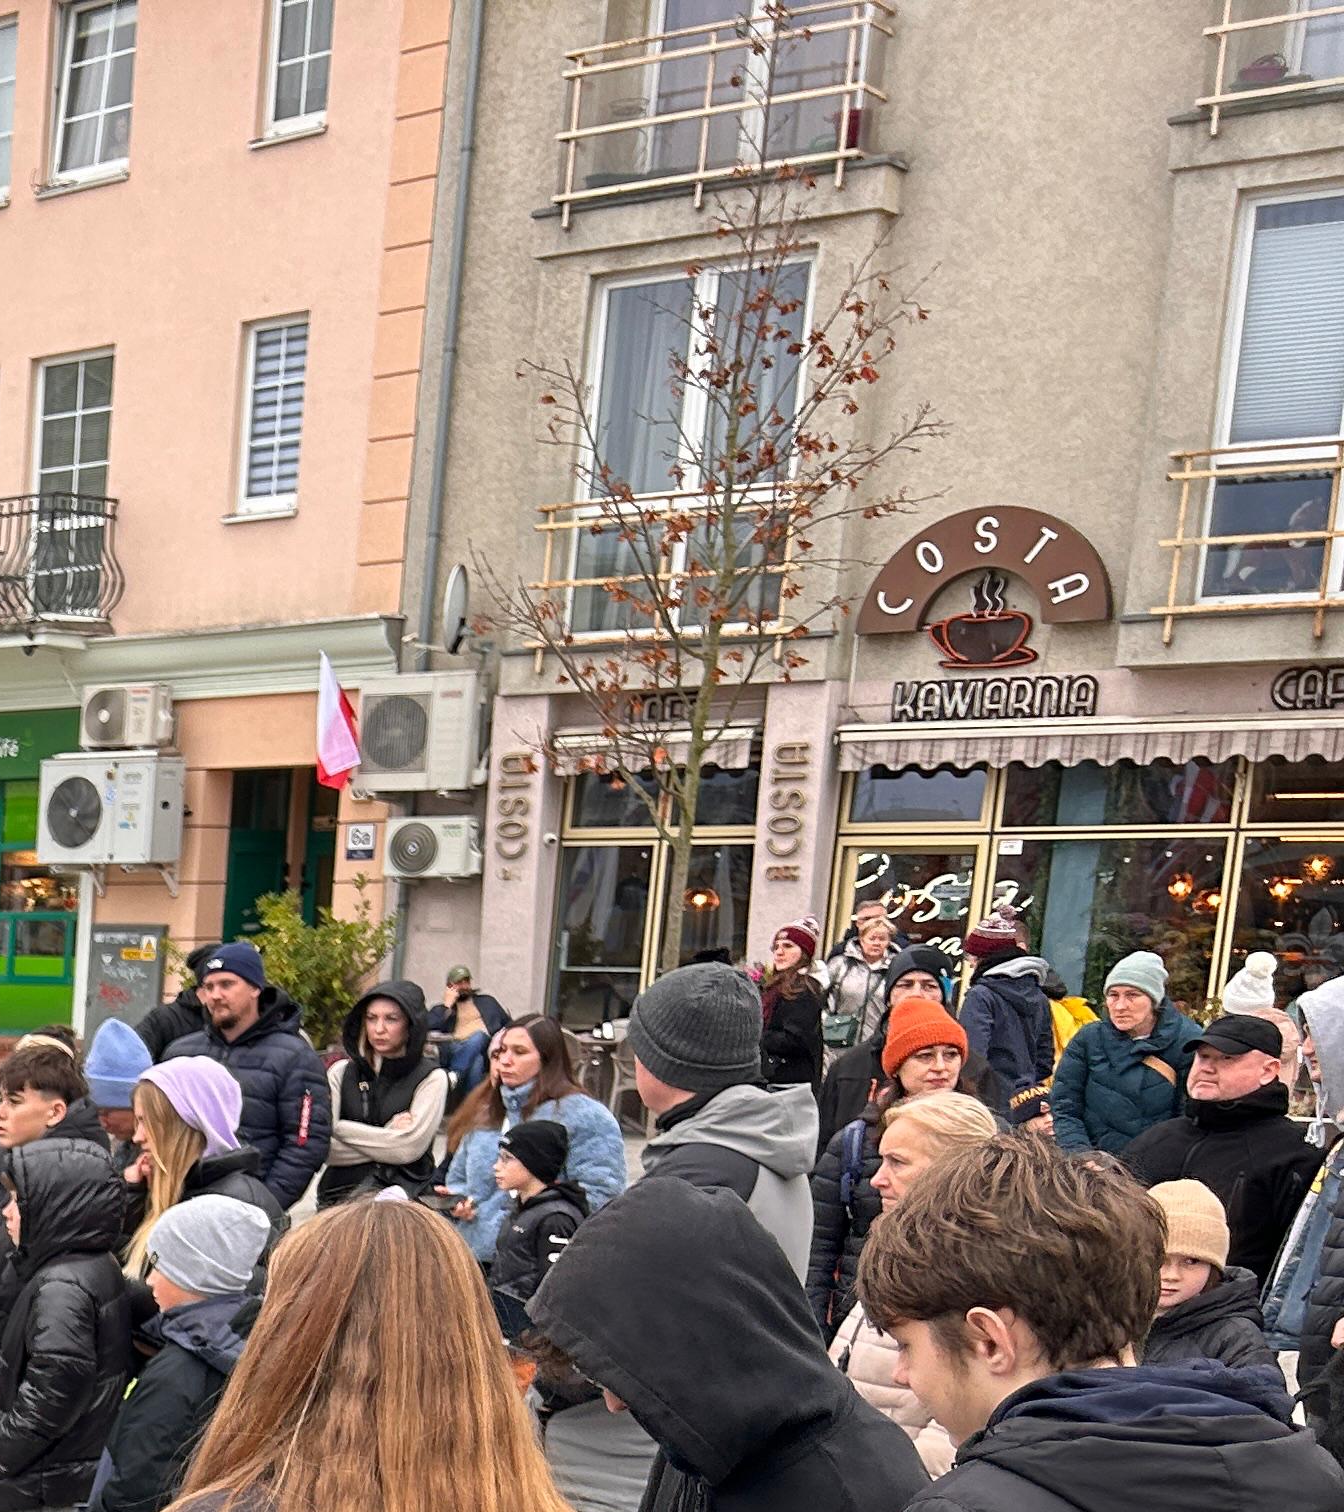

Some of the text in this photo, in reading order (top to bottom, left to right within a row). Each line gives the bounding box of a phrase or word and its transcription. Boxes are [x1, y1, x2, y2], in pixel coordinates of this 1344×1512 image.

[877, 516, 1090, 615] COSTA
[892, 676, 1098, 721] KAWIARNIA
[494, 752, 533, 860] COSTA
[765, 742, 810, 857] COSTA
